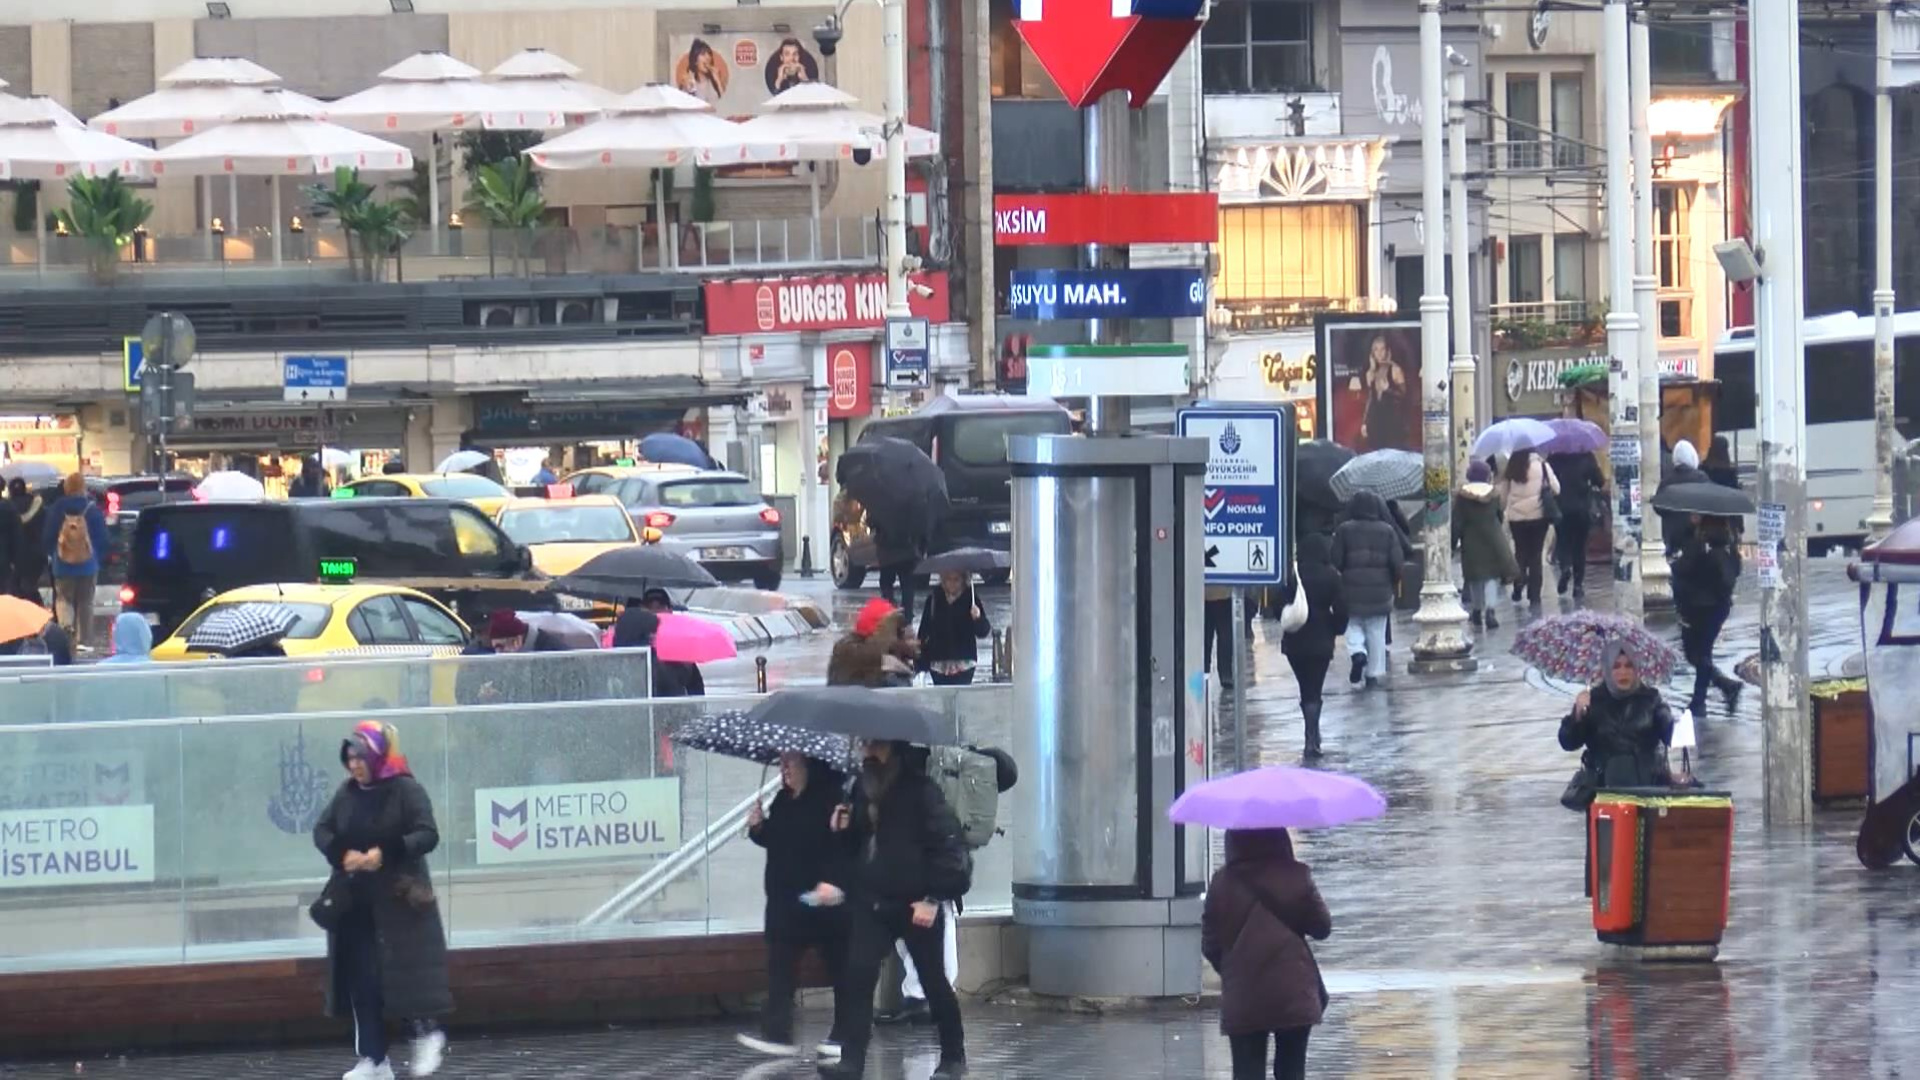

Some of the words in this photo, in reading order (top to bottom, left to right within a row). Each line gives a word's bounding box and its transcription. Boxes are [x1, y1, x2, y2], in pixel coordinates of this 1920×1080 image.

[779, 283, 848, 324] BURGER
[855, 281, 887, 320] KIN
[1064, 284, 1127, 304] MAH.
[836, 380, 855, 396] KING
[1226, 504, 1266, 514] NOKTASI
[1204, 523, 1226, 534] NFO
[1228, 523, 1263, 534] POINT
[535, 791, 627, 818] METRO
[2, 817, 98, 844] METRO
[536, 821, 665, 849] İSTANBUL
[3, 848, 138, 876] İSTANBUL
